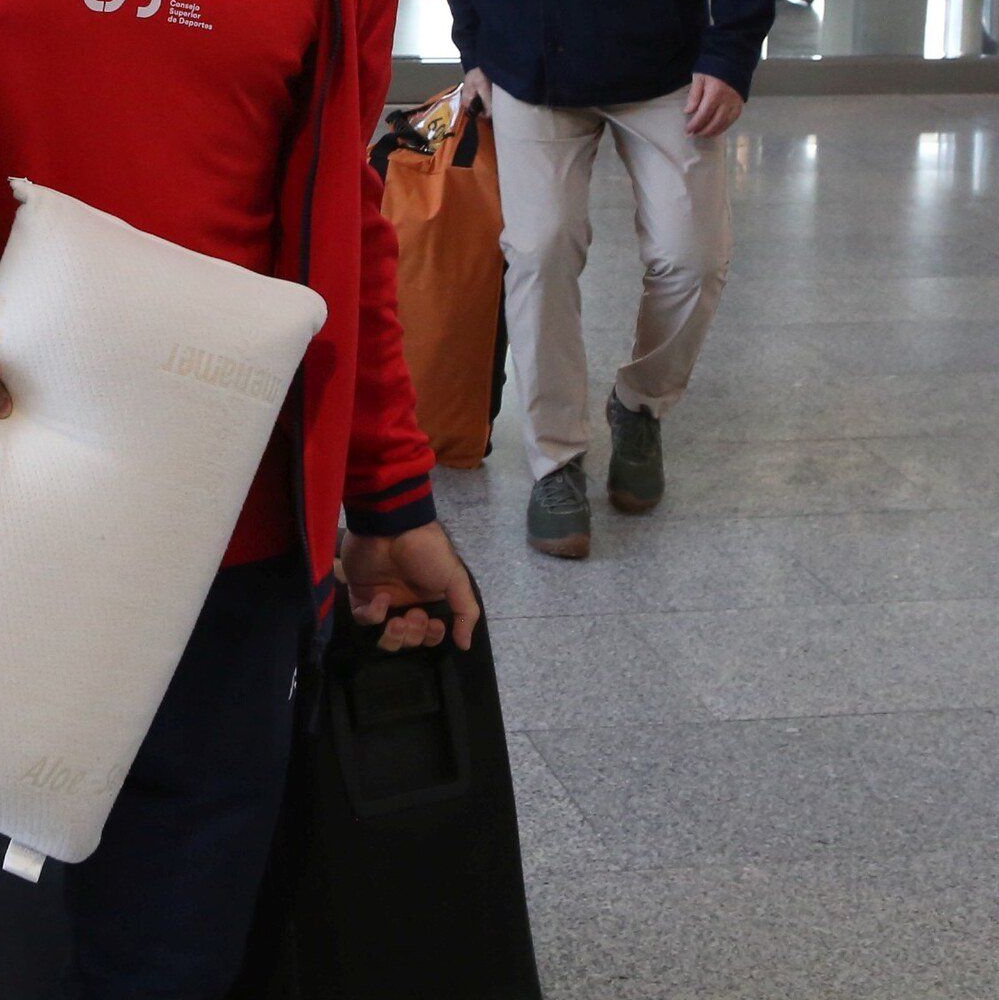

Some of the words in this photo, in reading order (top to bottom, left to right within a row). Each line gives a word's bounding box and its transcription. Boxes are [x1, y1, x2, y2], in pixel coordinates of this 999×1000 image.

[170, 0, 201, 13] Consejo
[169, 8, 202, 19] Superior
[179, 17, 213, 30] Deportes
